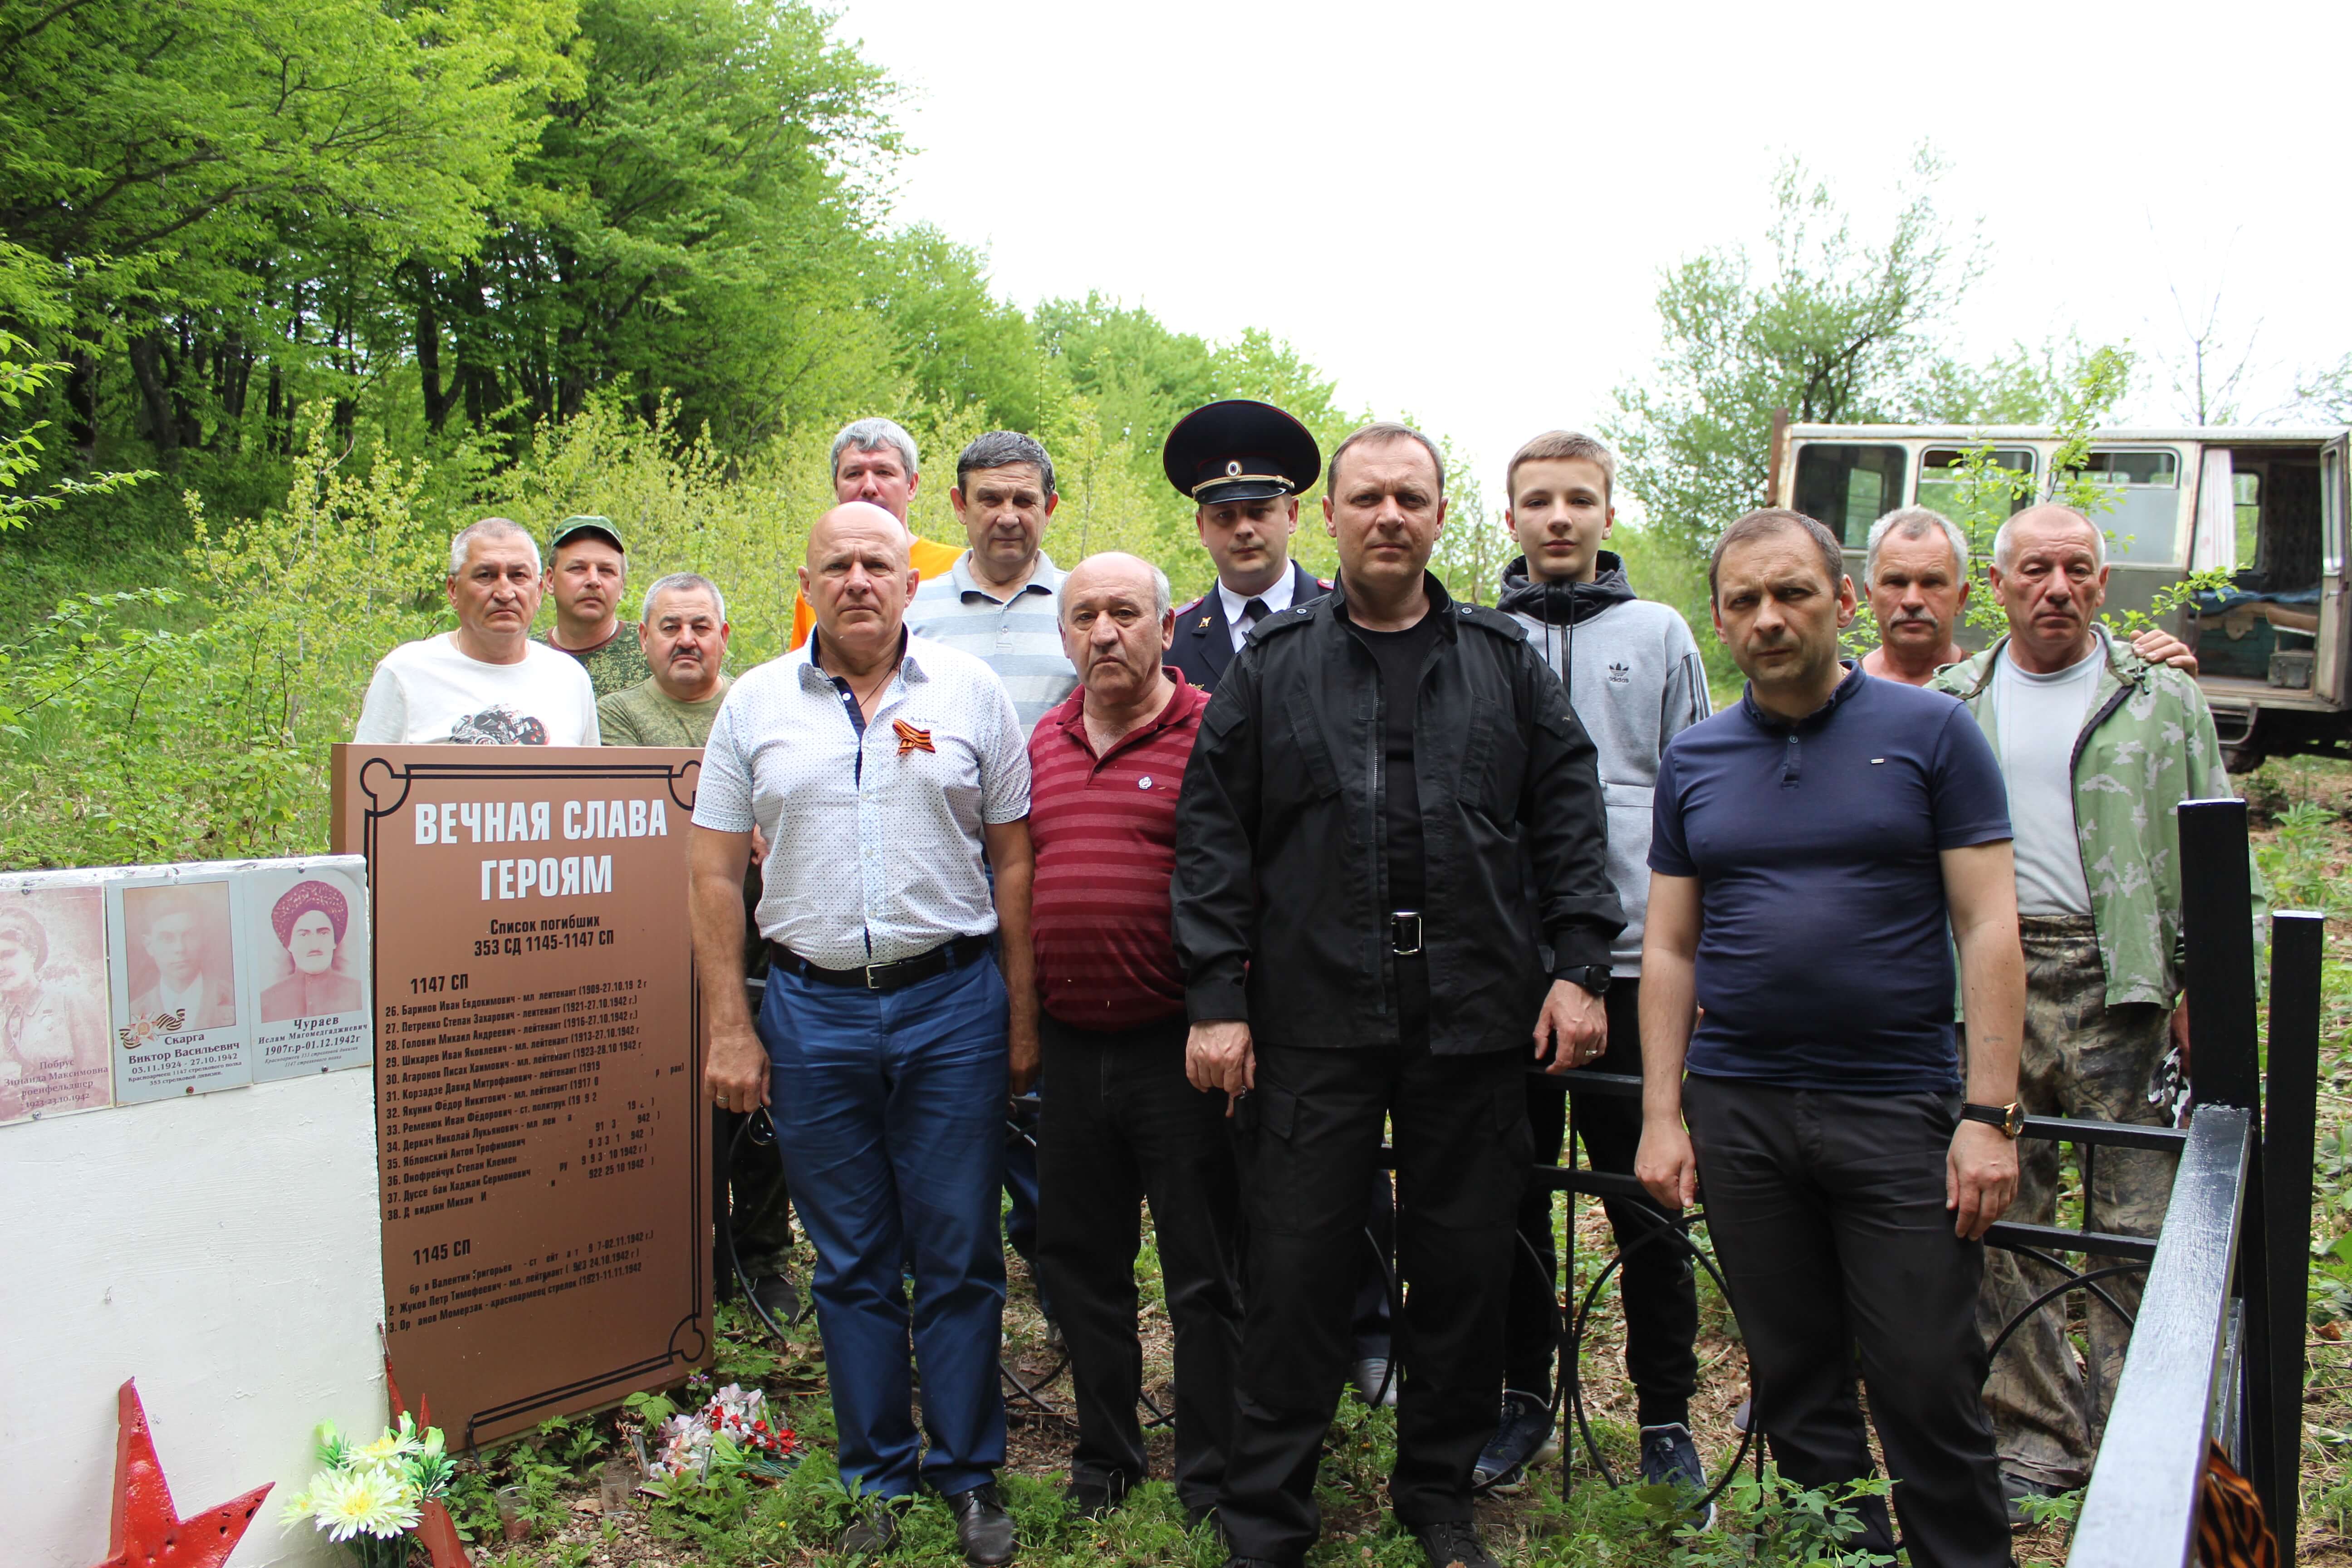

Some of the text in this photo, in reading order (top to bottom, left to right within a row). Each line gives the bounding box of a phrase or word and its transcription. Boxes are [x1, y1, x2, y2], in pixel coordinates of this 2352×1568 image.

[415, 799, 668, 844] ВЕЧНАЯ СЛАВА
[481, 855, 612, 900] ГЕРОЯМ
[490, 914, 600, 935] Список погибших
[474, 929, 614, 957] 353 СД 1145-1147 СП
[410, 973, 468, 995] 1147 СП
[385, 1006, 399, 1017] 26.
[402, 1004, 437, 1017] Баринов
[439, 1000, 460, 1011] Иван
[462, 996, 515, 1009] Евдокимович
[259, 1024, 368, 1044] Ислам Магомедгаджиевич
[294, 1017, 339, 1032] Чураев
[385, 1023, 399, 1034] 27.
[402, 1020, 441, 1033] Петренко
[443, 1017, 471, 1028] Степан
[473, 1012, 515, 1024] Захарович
[165, 1034, 205, 1045] Скарга
[265, 1035, 361, 1056] 1907г.р-01.12.1942г
[385, 1039, 399, 1052] 28.
[402, 1038, 436, 1049] Головин
[438, 1034, 470, 1044] Михаил
[473, 1028, 515, 1041] Андреевич
[523, 1022, 561, 1034] лейтенант
[128, 1042, 240, 1064] Виктор Васильевич
[132, 1060, 181, 1074] 03.11.1924
[190, 1053, 237, 1066] 27.10.1942
[386, 1057, 399, 1068] 29.
[402, 1054, 439, 1066] Шихарев
[441, 1050, 462, 1061] Иван
[464, 1045, 507, 1058] Яковлевич
[514, 1042, 529, 1051] мл.
[530, 1037, 568, 1049] лейтенант
[39, 1059, 74, 1069] Побрус
[128, 1072, 171, 1082] Красноармеец
[189, 1064, 224, 1073] стрелкового
[386, 1073, 400, 1085] 30.
[402, 1070, 441, 1083] Агаронов
[443, 1067, 467, 1077] Писах
[517, 1058, 531, 1067] мл.
[533, 1052, 571, 1064] лейтенант
[4, 1067, 108, 1087] Зинаида Максимовна
[162, 1074, 196, 1084] стрелковой
[386, 1091, 400, 1102] 31.
[402, 1087, 443, 1101] Корзадзе
[445, 1083, 471, 1095] Давид
[473, 1073, 532, 1089] Митрофанович
[539, 1067, 577, 1079] лейтенант
[22, 1081, 93, 1097] военфельдшер
[26, 1093, 90, 1107] 1923-23.10.1942
[386, 1107, 400, 1119] 32.
[402, 1105, 432, 1117] Якунин
[435, 1099, 462, 1111] Фёдор
[465, 1093, 506, 1107] Никитович
[514, 1090, 528, 1099] мл.
[529, 1083, 568, 1097] лейтенант
[387, 1124, 400, 1136] 33.
[402, 1120, 442, 1133] Ременюк
[445, 1116, 465, 1127] Иван
[467, 1109, 512, 1122] Фёдорович
[519, 1106, 530, 1114] ст.
[532, 1100, 566, 1112] политрук
[387, 1141, 400, 1153] 34.
[403, 1138, 433, 1152] Деркач
[436, 1132, 470, 1145] Николай
[472, 1123, 519, 1140] Лукьянович
[387, 1138, 525, 1170] 35. Яблонский Антон Трофимович
[387, 1175, 401, 1187] 36.
[403, 1168, 454, 1184] Онофрейчук
[456, 1162, 484, 1174] Степан
[387, 1192, 401, 1204] 37.
[483, 1169, 531, 1186] Сермонович
[387, 1209, 401, 1221] 38.
[412, 1239, 470, 1265] 1145 СП
[431, 1274, 470, 1289] Валентин
[389, 1322, 397, 1333] 3.
[440, 1303, 483, 1321] Момерзак
[490, 1288, 546, 1309] красноармеец
[548, 1280, 577, 1294] стрелок
[400, 1300, 426, 1314] Жуков
[429, 1295, 448, 1307] Петр
[450, 1283, 501, 1301] Тимофеевич
[509, 1278, 523, 1287] мл.
